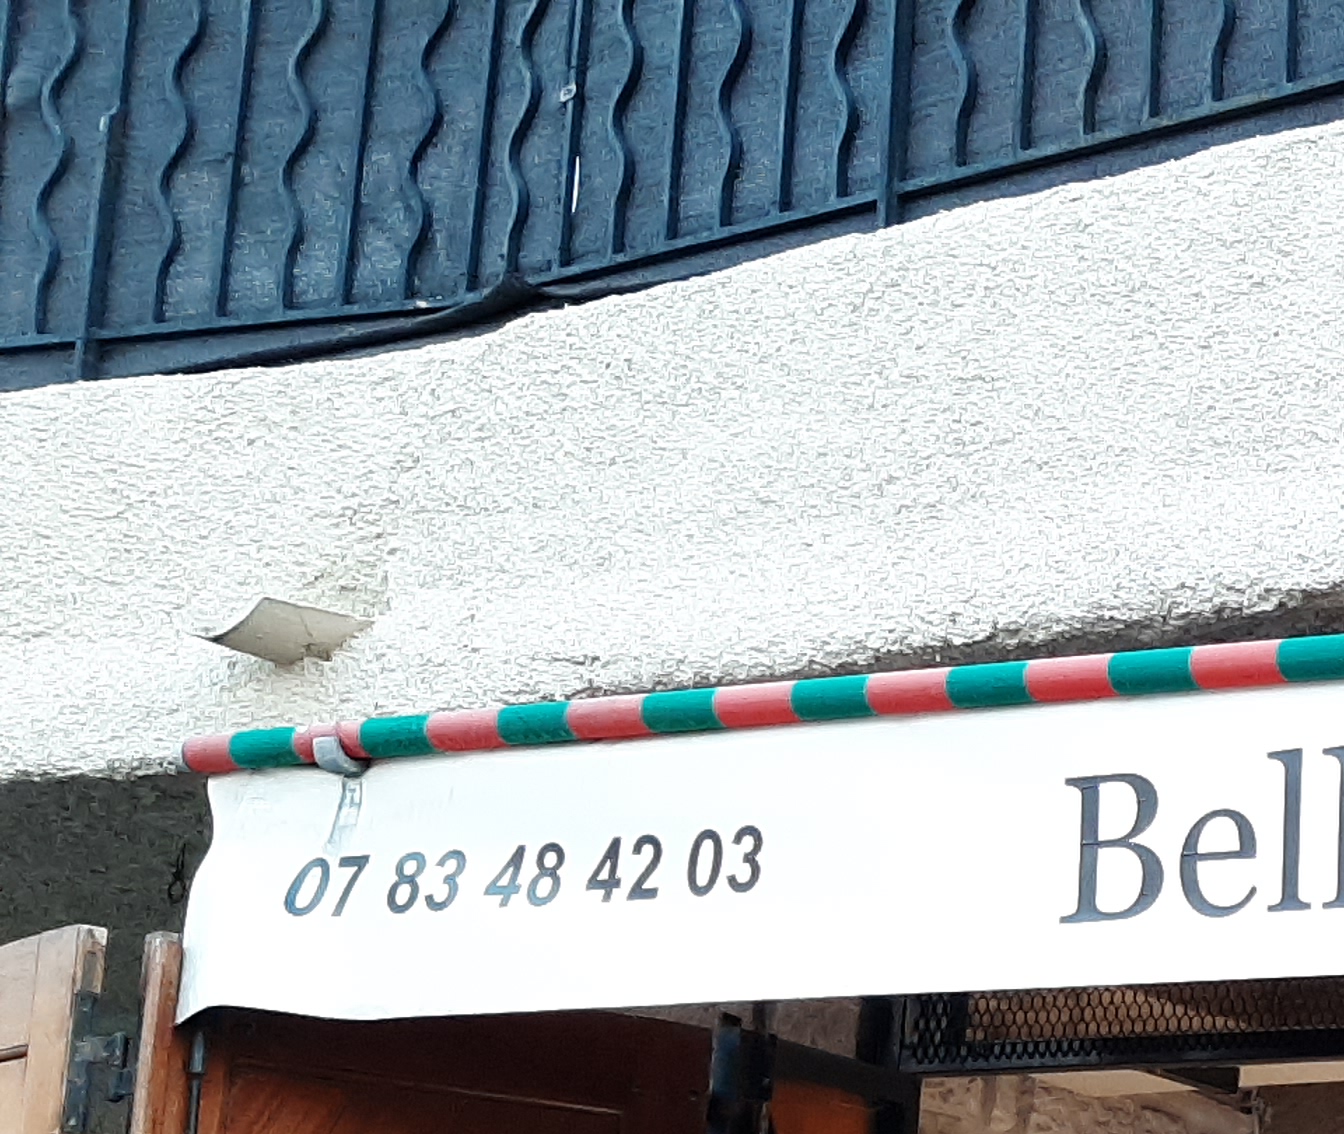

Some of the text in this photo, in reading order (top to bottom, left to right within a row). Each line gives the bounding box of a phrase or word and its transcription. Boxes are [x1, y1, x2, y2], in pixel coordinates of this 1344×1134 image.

[284, 825, 763, 916] 07 83 48 42 03
